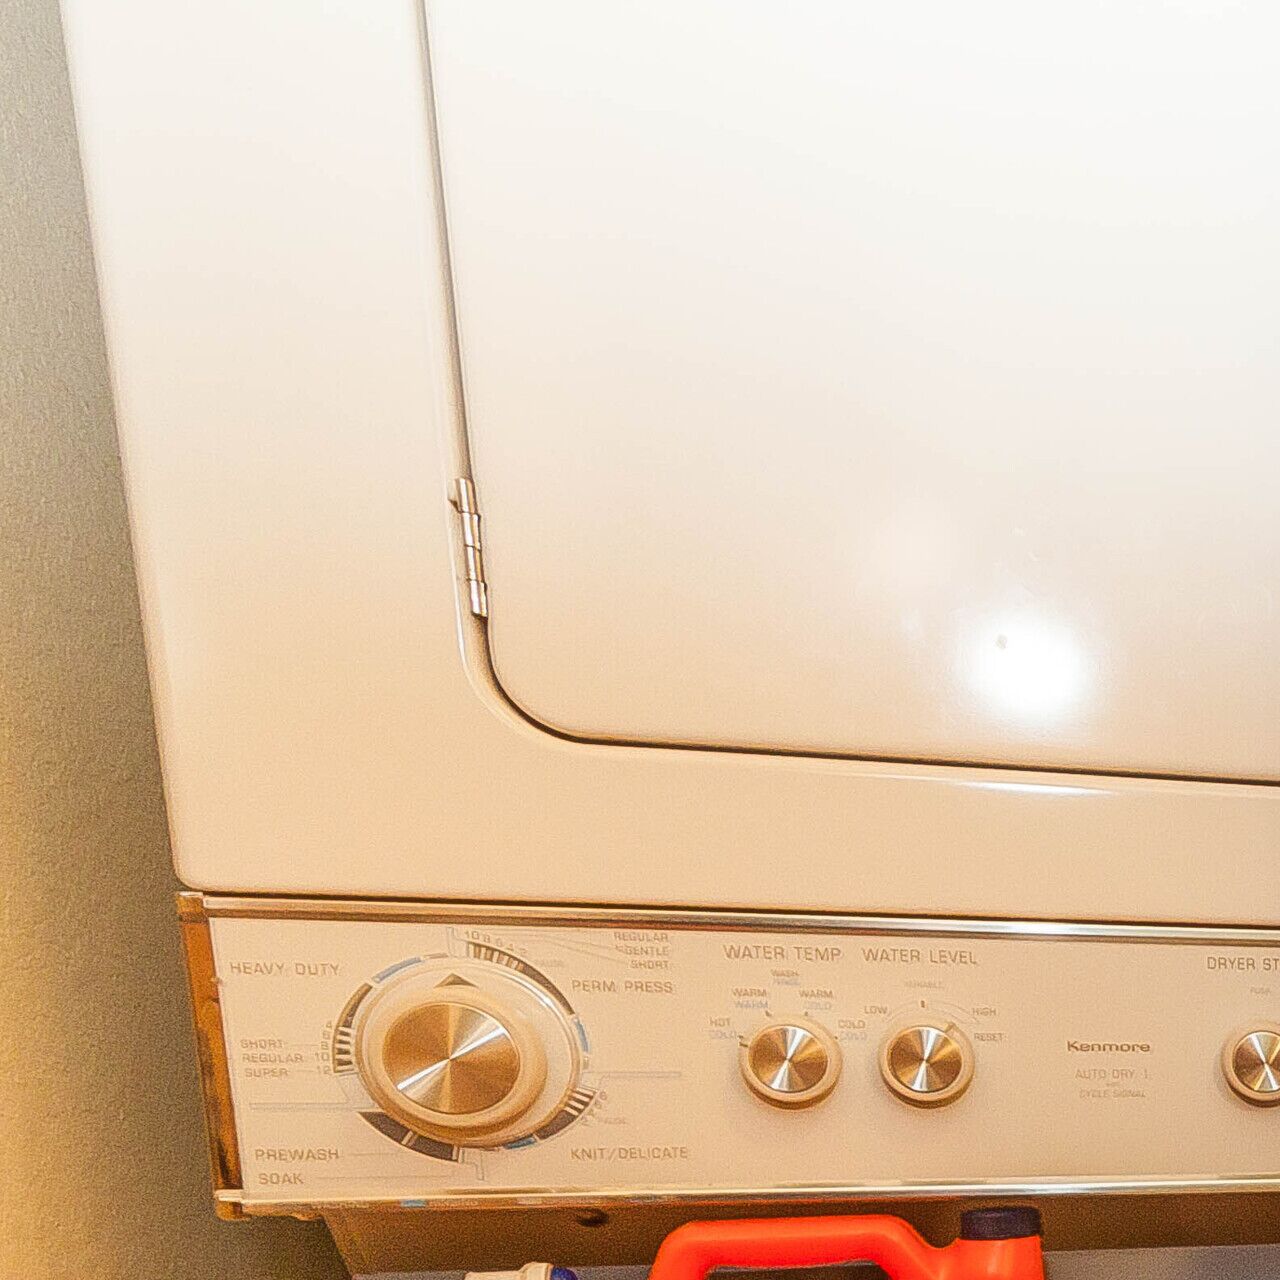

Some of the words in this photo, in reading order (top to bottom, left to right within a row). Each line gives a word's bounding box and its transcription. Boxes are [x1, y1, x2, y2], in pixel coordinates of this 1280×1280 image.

[614, 932, 670, 942] REGULAR
[723, 945, 785, 960] WATER
[794, 947, 841, 961] TEMP
[862, 948, 920, 962] WATER
[930, 950, 977, 965] LEVEL
[230, 962, 284, 976] HEAVY
[295, 962, 341, 976] DUTY
[1207, 957, 1255, 971] DRYER
[572, 980, 616, 992] PERM
[624, 981, 673, 993] PRESS
[732, 988, 767, 997] WARM
[799, 989, 833, 998] WARM
[864, 1005, 888, 1015] LOW
[709, 1017, 731, 1027] HOT
[1067, 1041, 1151, 1052] Kenmore
[1075, 1068, 1107, 1080] AUTO
[255, 1148, 339, 1161] PREWASH
[571, 1146, 688, 1161] KNIT/DELICATE
[258, 1172, 304, 1185] SOAK
